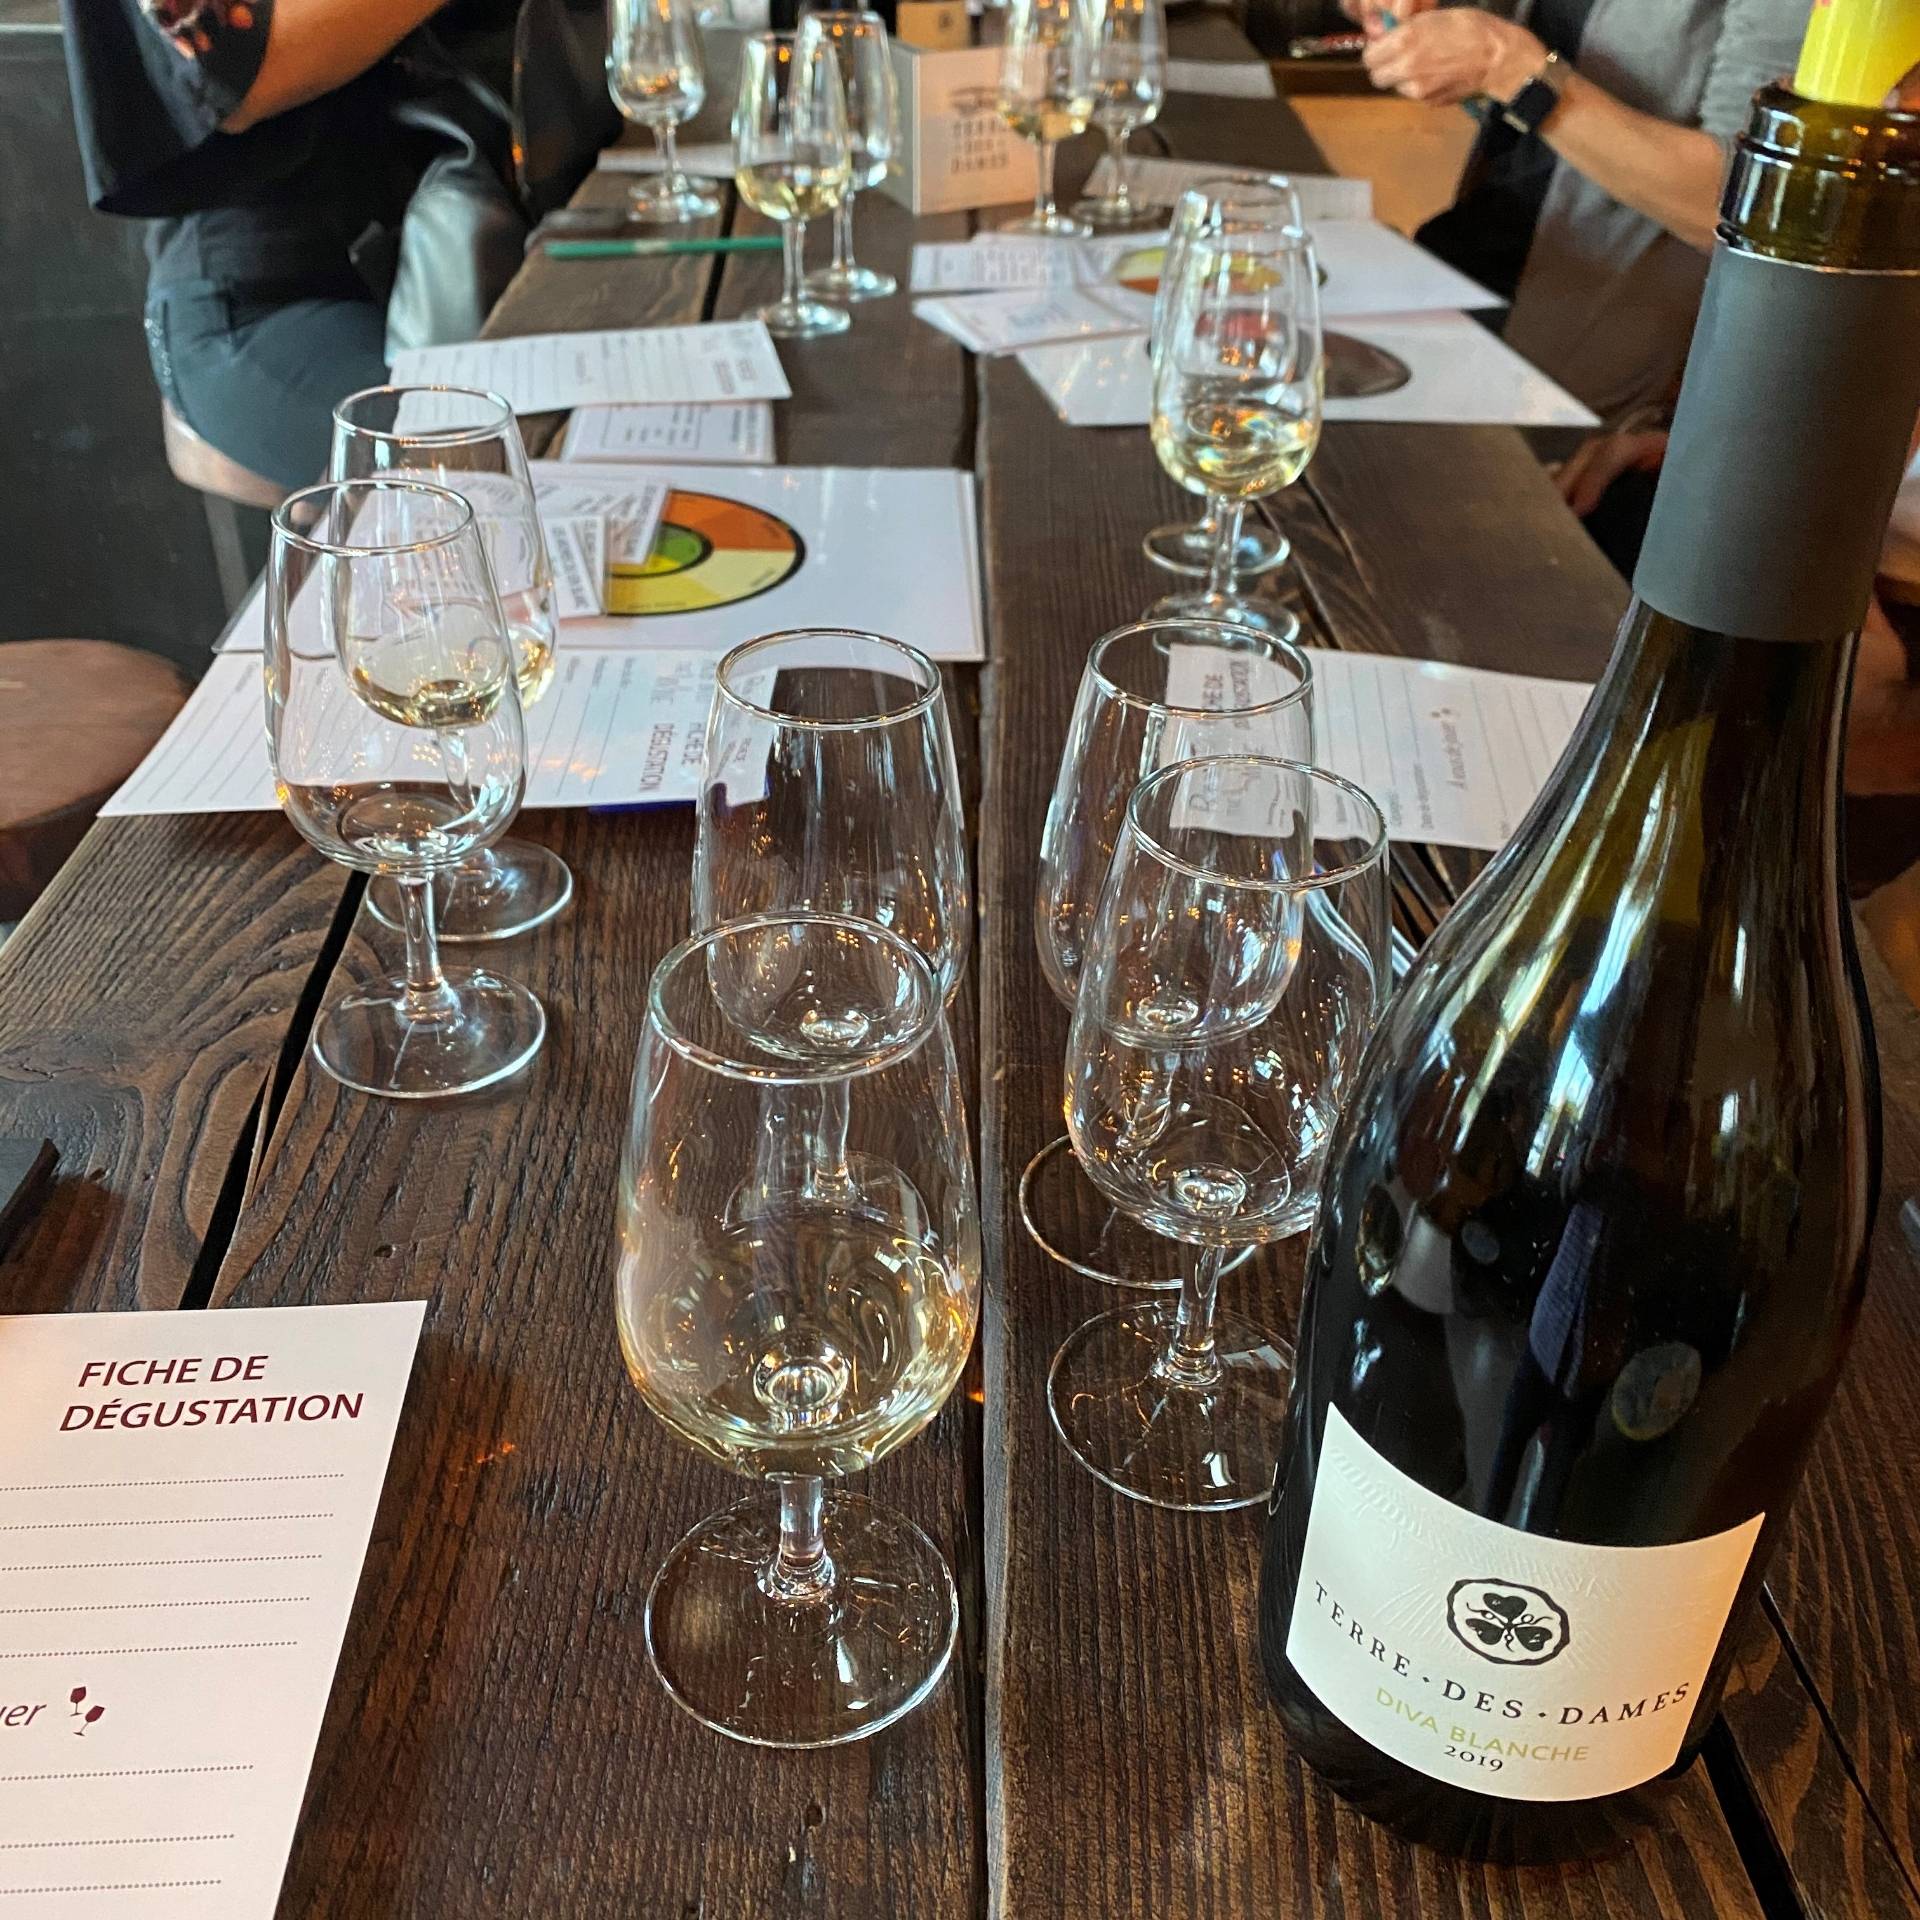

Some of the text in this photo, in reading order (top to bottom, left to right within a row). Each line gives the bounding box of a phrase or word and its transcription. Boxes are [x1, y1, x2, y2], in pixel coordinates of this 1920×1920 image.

[78, 1355, 269, 1388] FICHE DE
[59, 1393, 364, 1431] DÉGUSTATION
[1315, 1580, 1689, 1725] TERRE DES DAMES
[1376, 1687, 1590, 1761] DIVA BLANCHE
[1443, 1745, 1503, 1772] 2019
